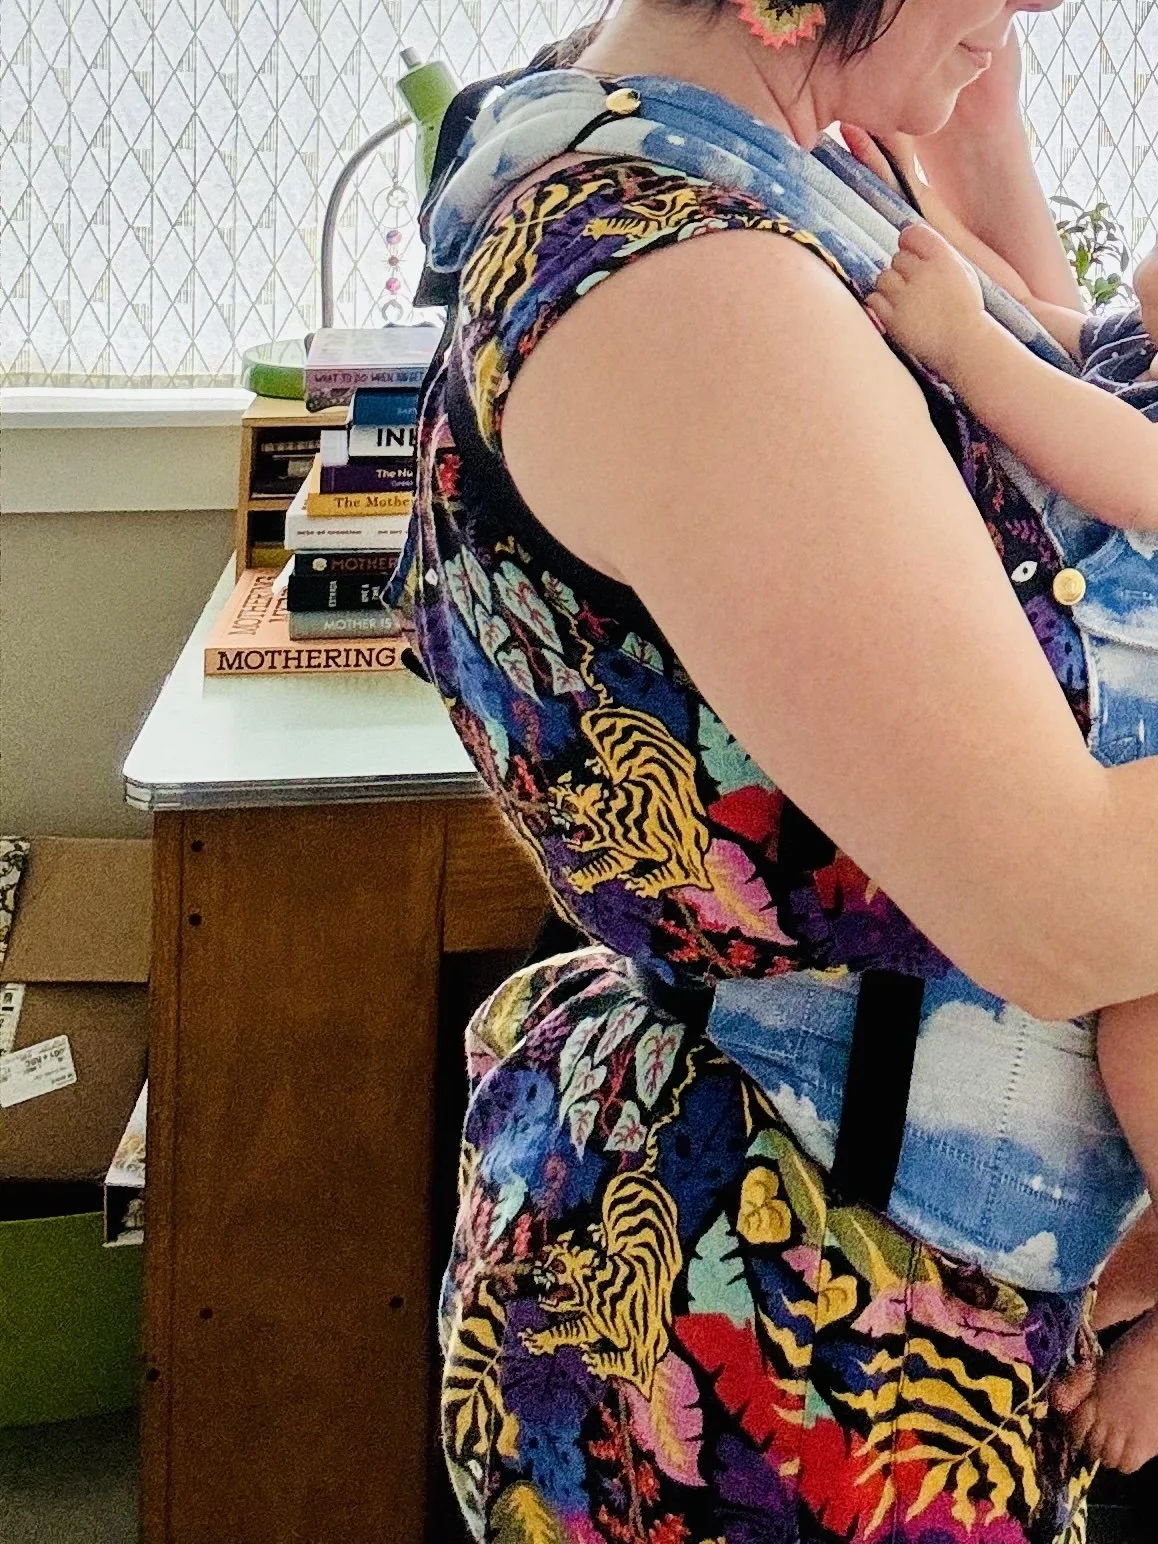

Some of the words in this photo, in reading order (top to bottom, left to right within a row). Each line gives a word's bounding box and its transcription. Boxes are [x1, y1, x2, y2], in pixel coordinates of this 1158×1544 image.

[376, 469, 397, 478] The
[333, 496, 361, 509] The
[331, 556, 399, 571] MOTHER
[323, 618, 377, 631] MOTHER
[216, 647, 396, 671] MOTHERING
